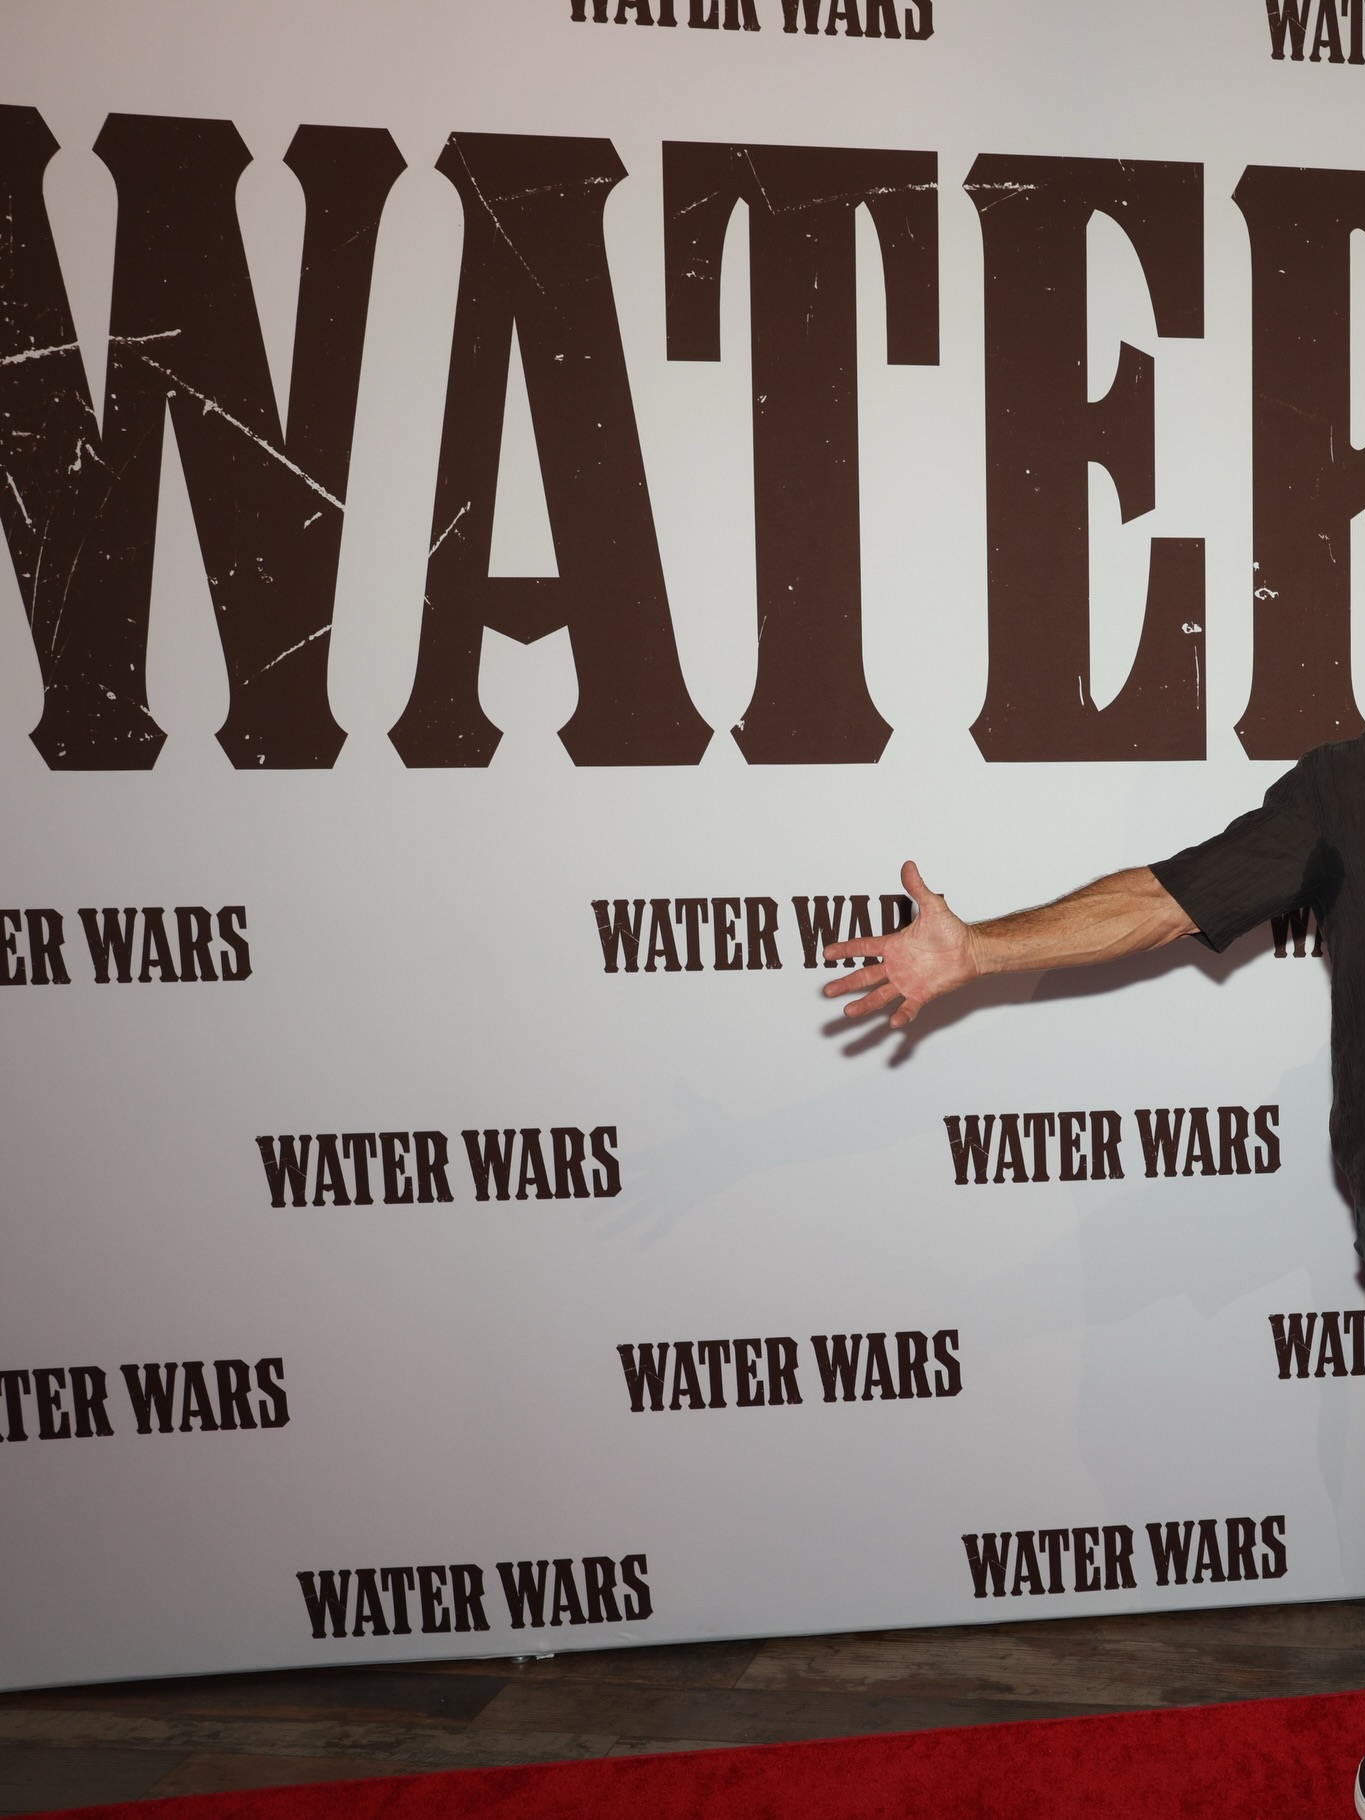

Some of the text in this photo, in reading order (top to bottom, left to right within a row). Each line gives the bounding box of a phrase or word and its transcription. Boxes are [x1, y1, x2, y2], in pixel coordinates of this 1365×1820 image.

[78, 906, 252, 984] WARS
[591, 894, 944, 973] WATER WAR
[255, 1126, 622, 1208] WATER WARS
[943, 1105, 1281, 1185] WATER WARS
[0, 1358, 290, 1442] TER WARS
[616, 1329, 962, 1412] WATER WARS
[296, 1554, 653, 1639] WATER WARS
[961, 1515, 1288, 1598] WATER WARS
